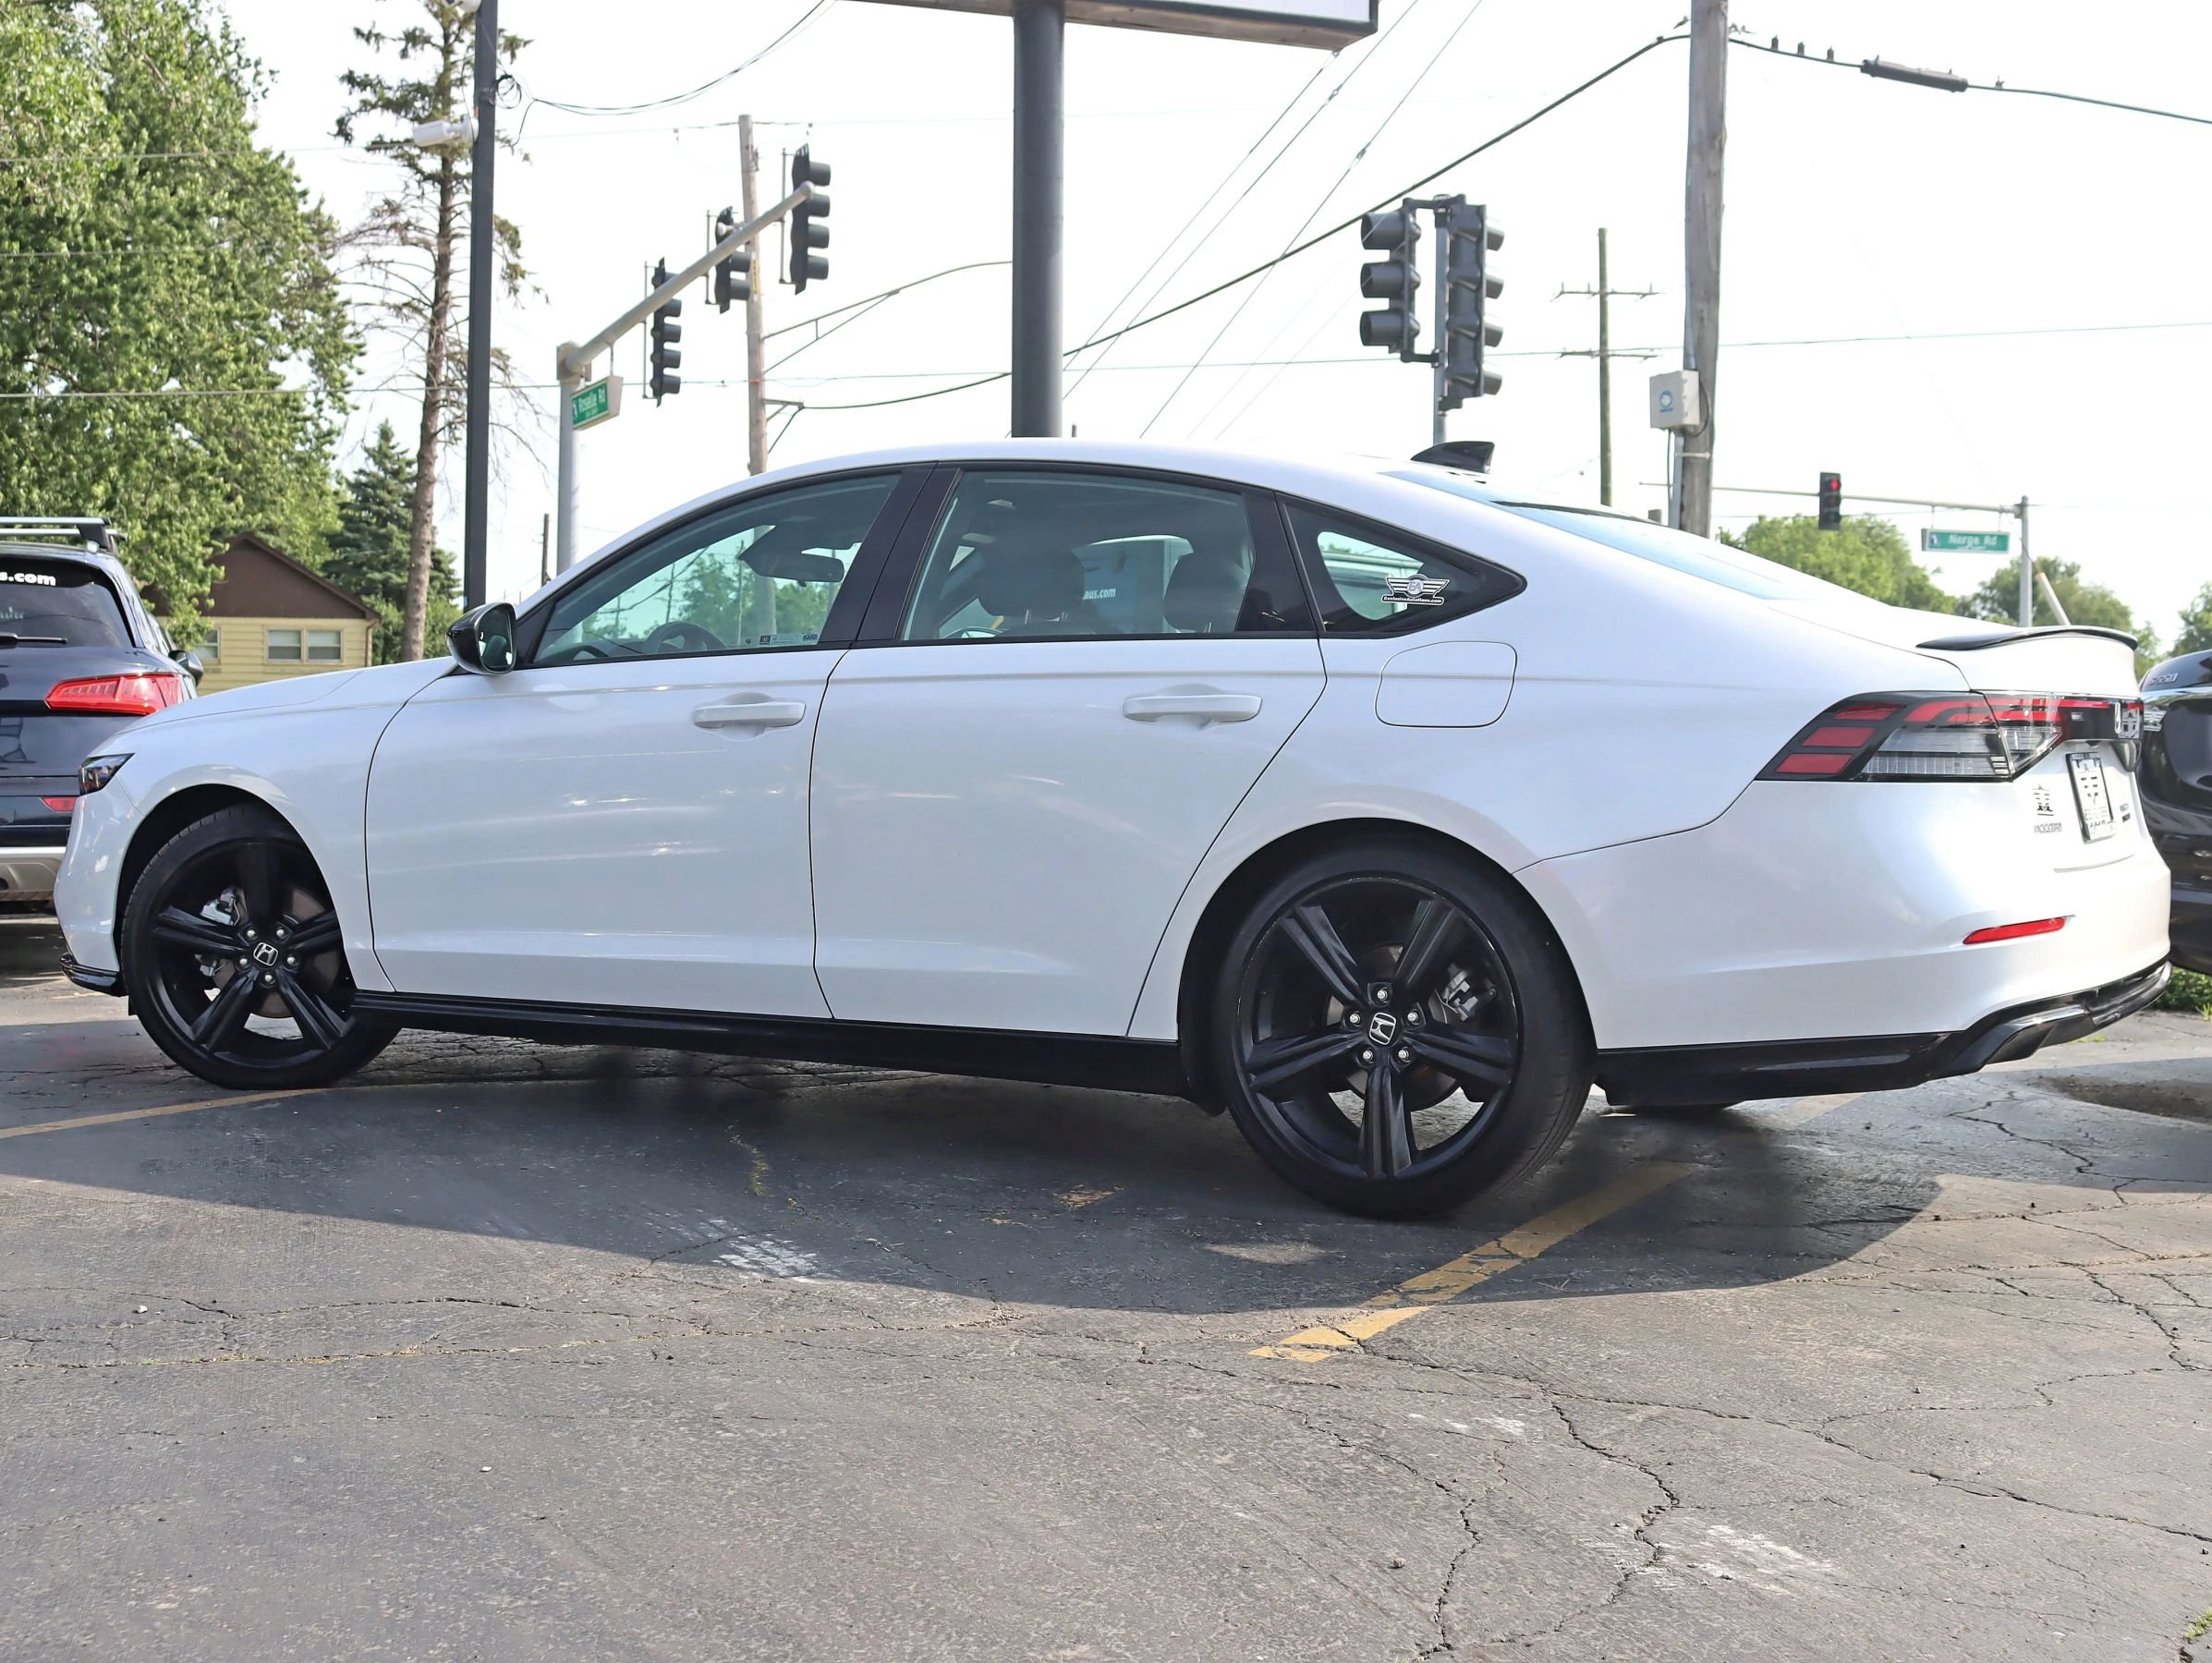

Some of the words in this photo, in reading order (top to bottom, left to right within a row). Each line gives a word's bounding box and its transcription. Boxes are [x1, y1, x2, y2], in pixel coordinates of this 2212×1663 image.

[598, 384, 606, 404] Rd
[1949, 534, 1980, 548] Nerge
[1983, 535, 1998, 546] Rd
